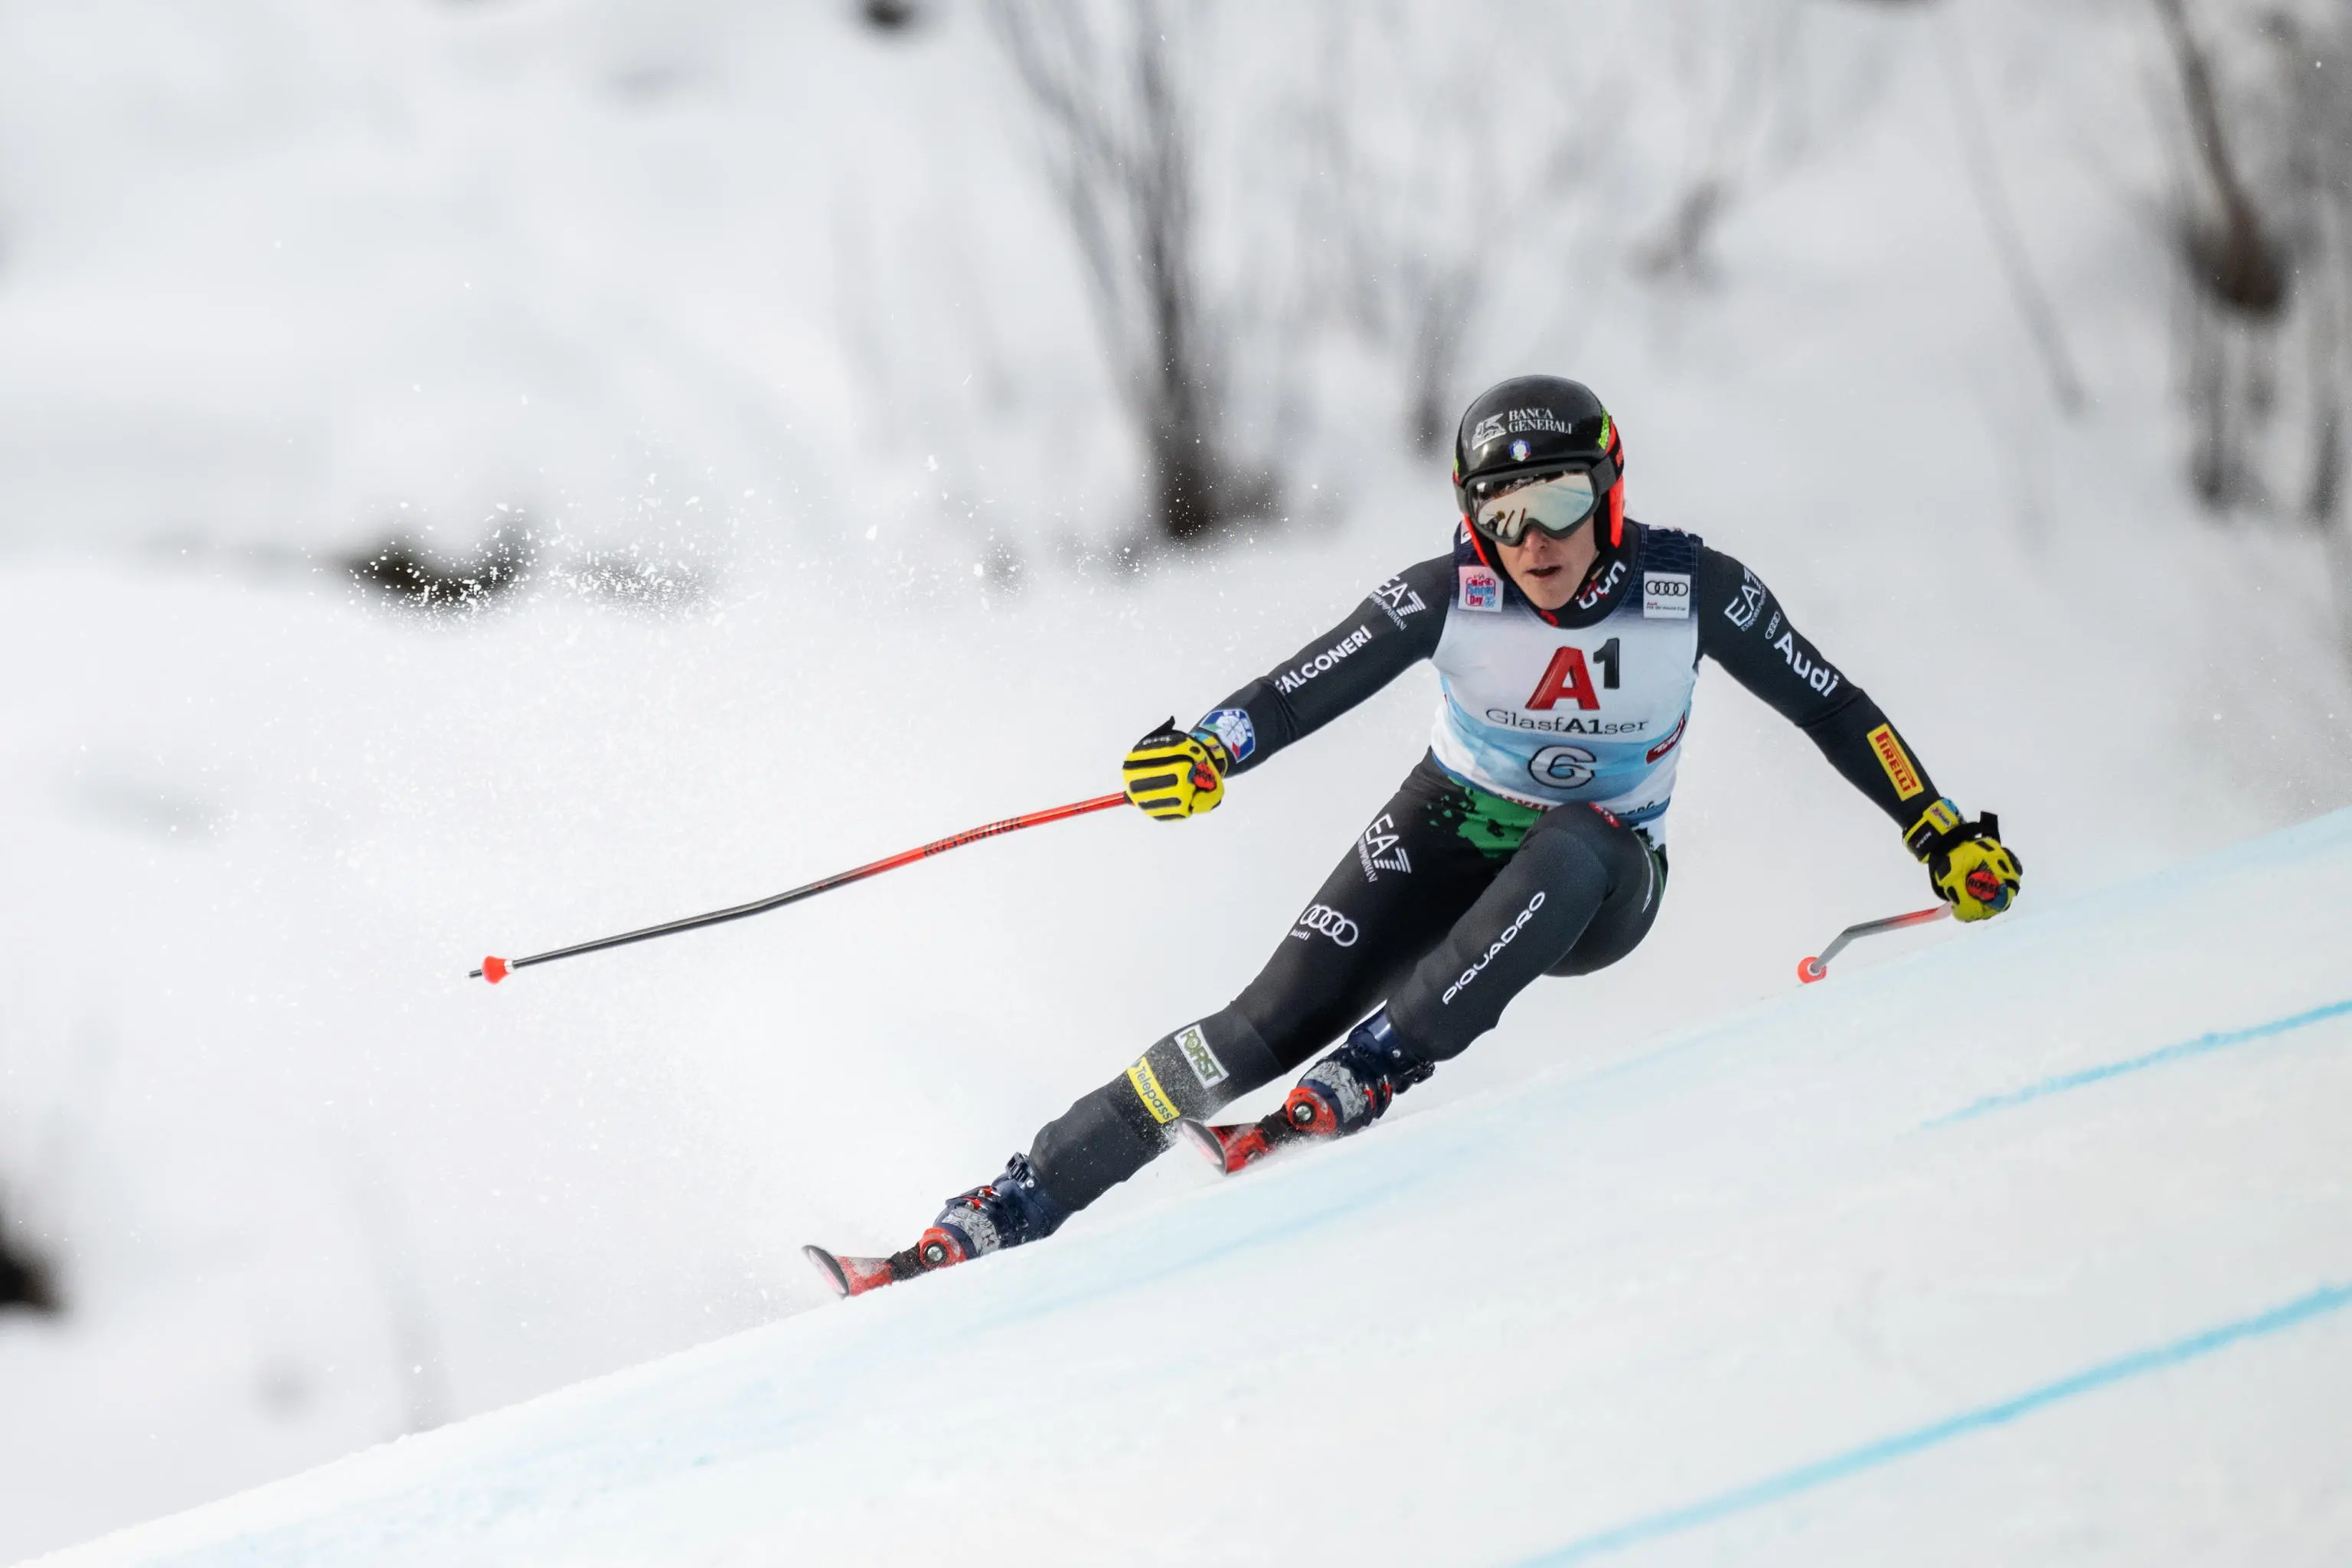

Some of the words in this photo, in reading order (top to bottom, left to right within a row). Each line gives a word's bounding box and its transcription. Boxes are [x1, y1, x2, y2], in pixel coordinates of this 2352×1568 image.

[1509, 408, 1553, 420] BANCA
[1509, 419, 1573, 434] GENERALI
[1525, 638, 1620, 710] A1
[1773, 630, 1839, 697] Audi
[1486, 708, 1649, 735] GlasfA1ser
[1527, 744, 1596, 789] 6
[1874, 731, 1917, 792] PIRELLI
[1365, 813, 1412, 874] EA7
[1442, 890, 1546, 1004] PIQUADRO
[1181, 1028, 1223, 1082] FORST
[1135, 1066, 1173, 1120] Telepass
